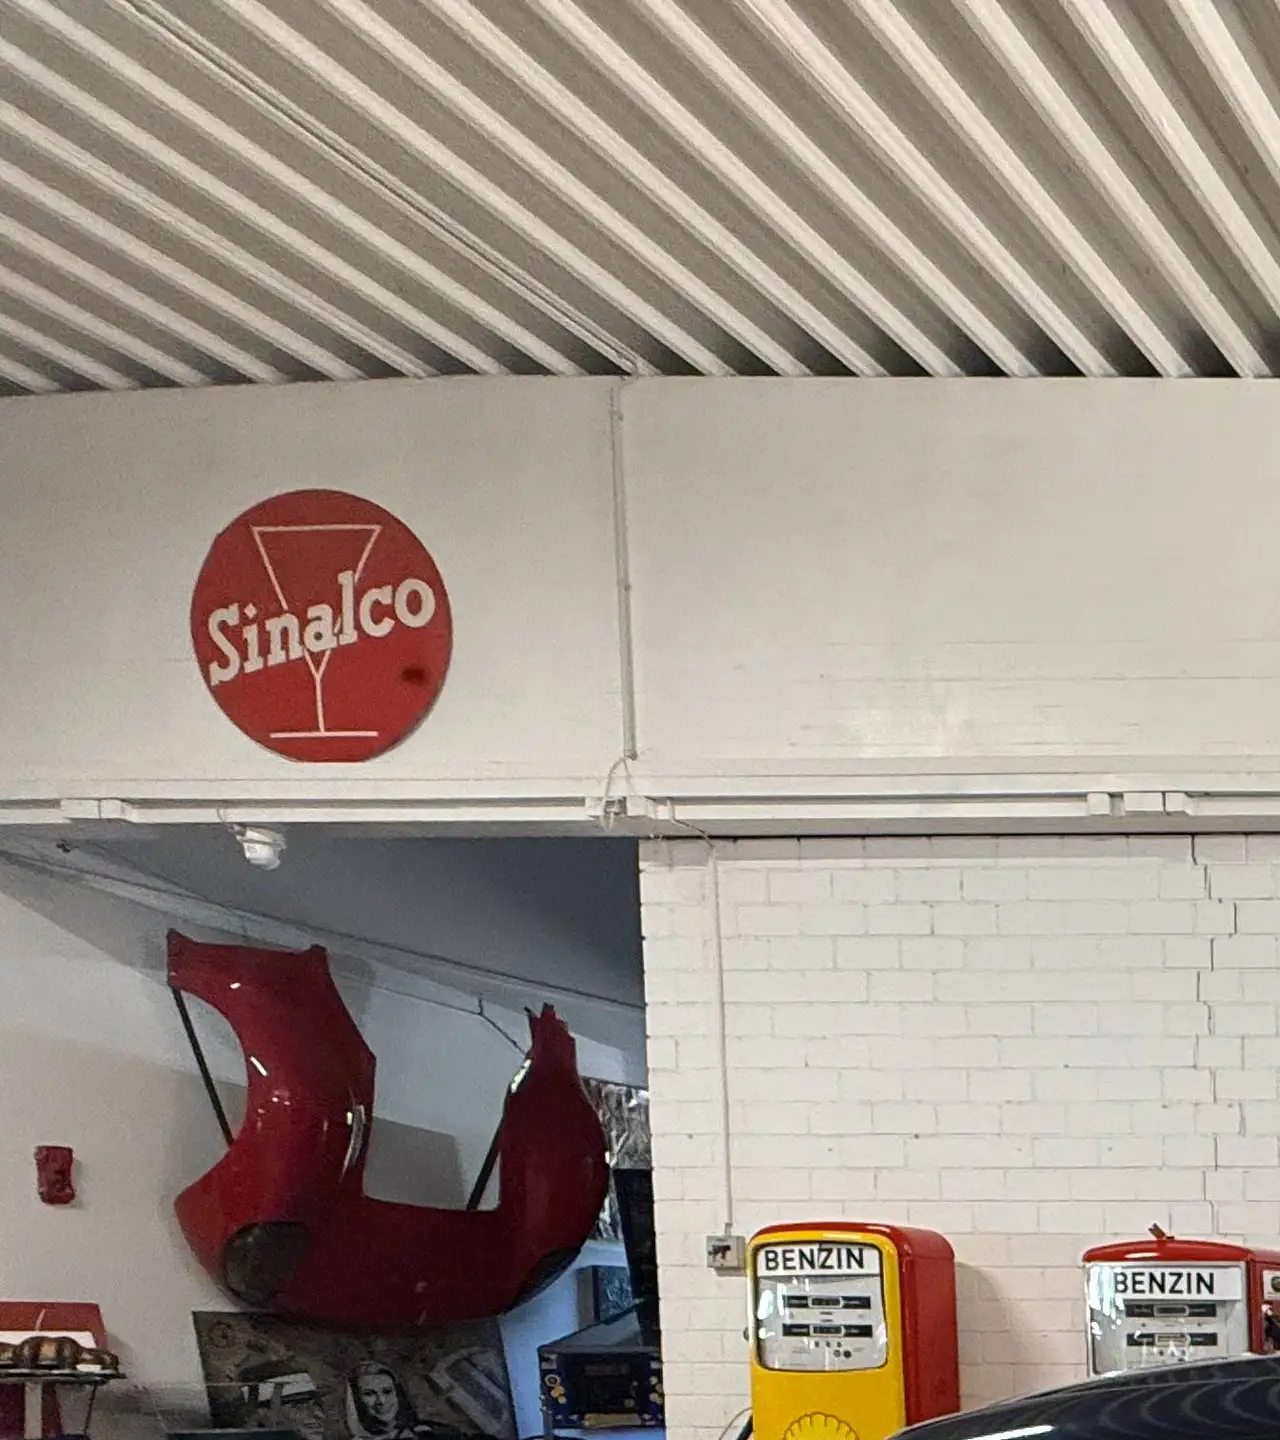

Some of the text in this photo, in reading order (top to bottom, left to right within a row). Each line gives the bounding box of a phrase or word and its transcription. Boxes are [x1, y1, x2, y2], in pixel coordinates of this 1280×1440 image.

[208, 570, 436, 686] Sinalco
[764, 1246, 864, 1271] BENZIN
[1115, 1272, 1214, 1294] BENZIN
